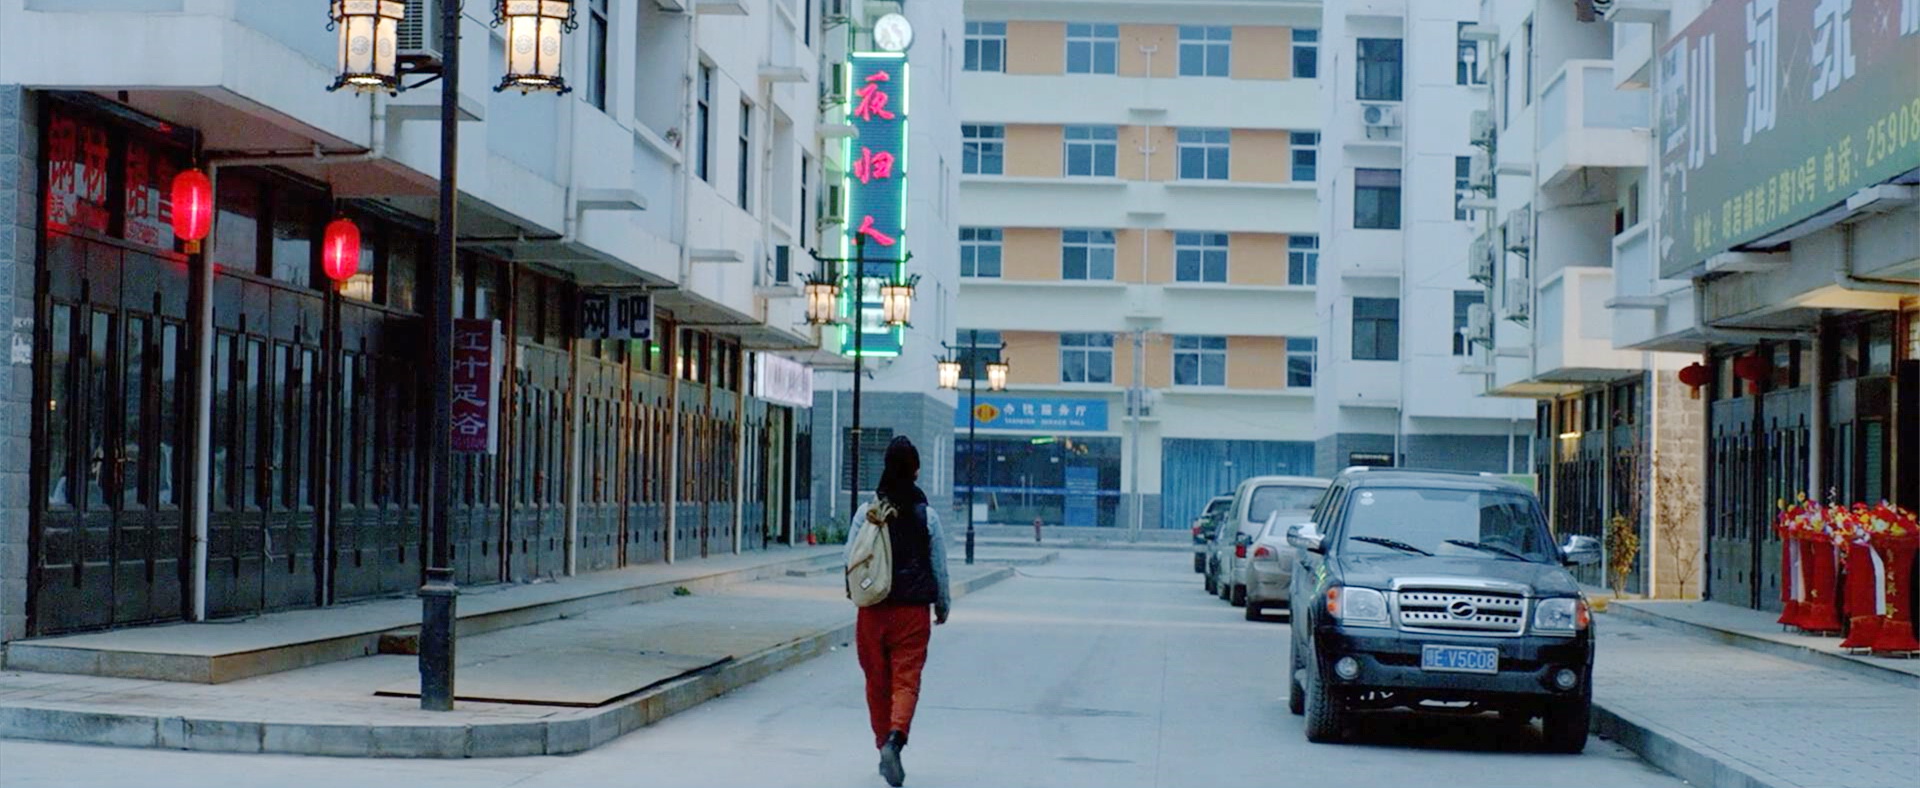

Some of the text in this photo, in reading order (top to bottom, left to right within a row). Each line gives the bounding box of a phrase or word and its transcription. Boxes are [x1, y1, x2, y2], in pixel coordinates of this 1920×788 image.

[851, 70, 896, 247] 夜归人
[581, 294, 650, 339] 网吧
[451, 331, 489, 436] 红叶足浴
